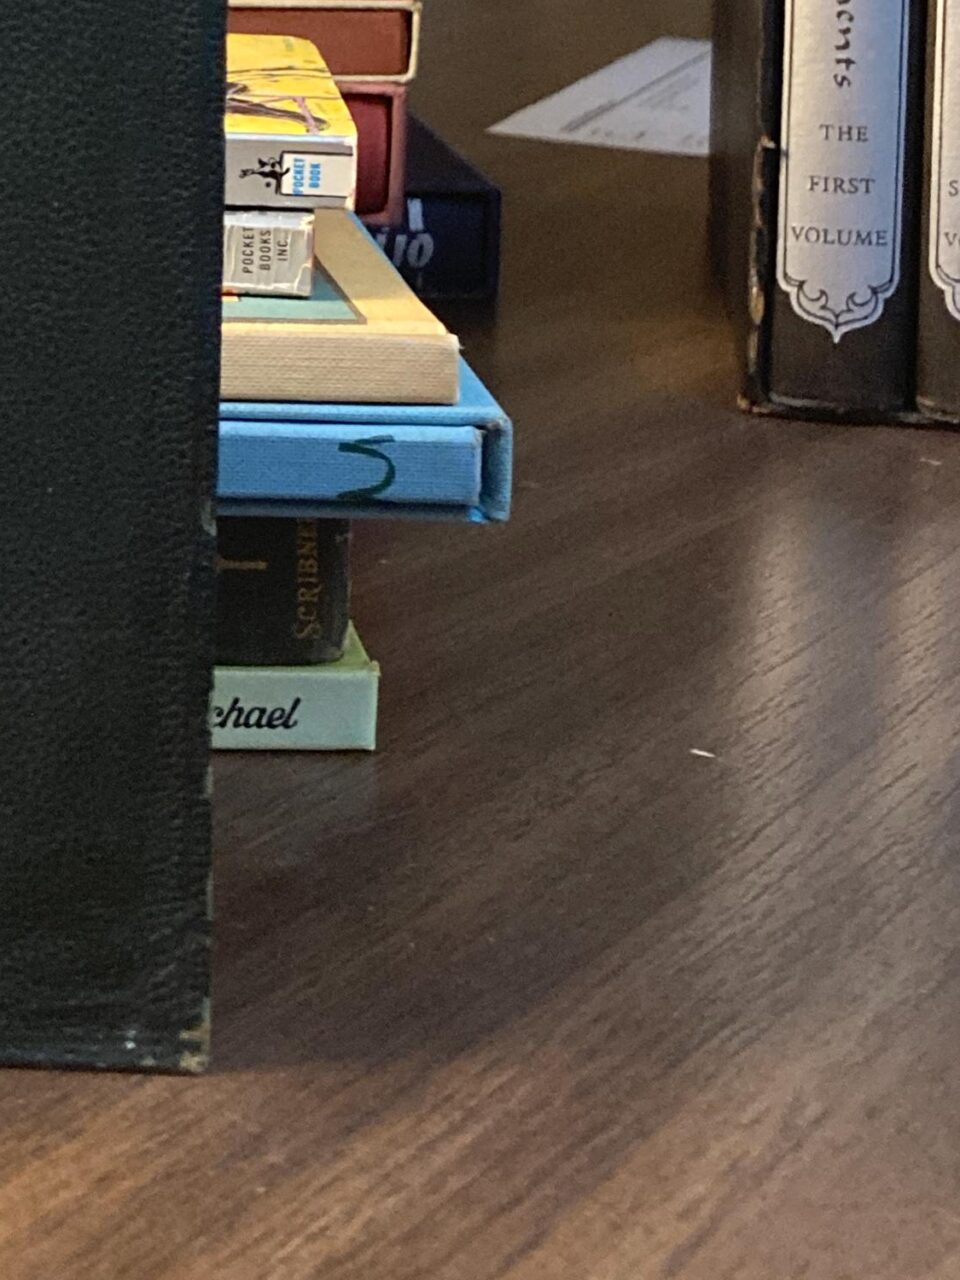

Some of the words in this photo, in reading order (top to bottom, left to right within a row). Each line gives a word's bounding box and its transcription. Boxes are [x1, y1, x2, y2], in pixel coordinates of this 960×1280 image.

[819, 123, 869, 143] THE
[292, 157, 305, 196] POCKET
[308, 163, 321, 188] BOOK
[808, 174, 876, 195] FIRST
[791, 225, 889, 247] VOLUME
[242, 226, 255, 274] POCKET
[258, 230, 272, 272] BOOKS
